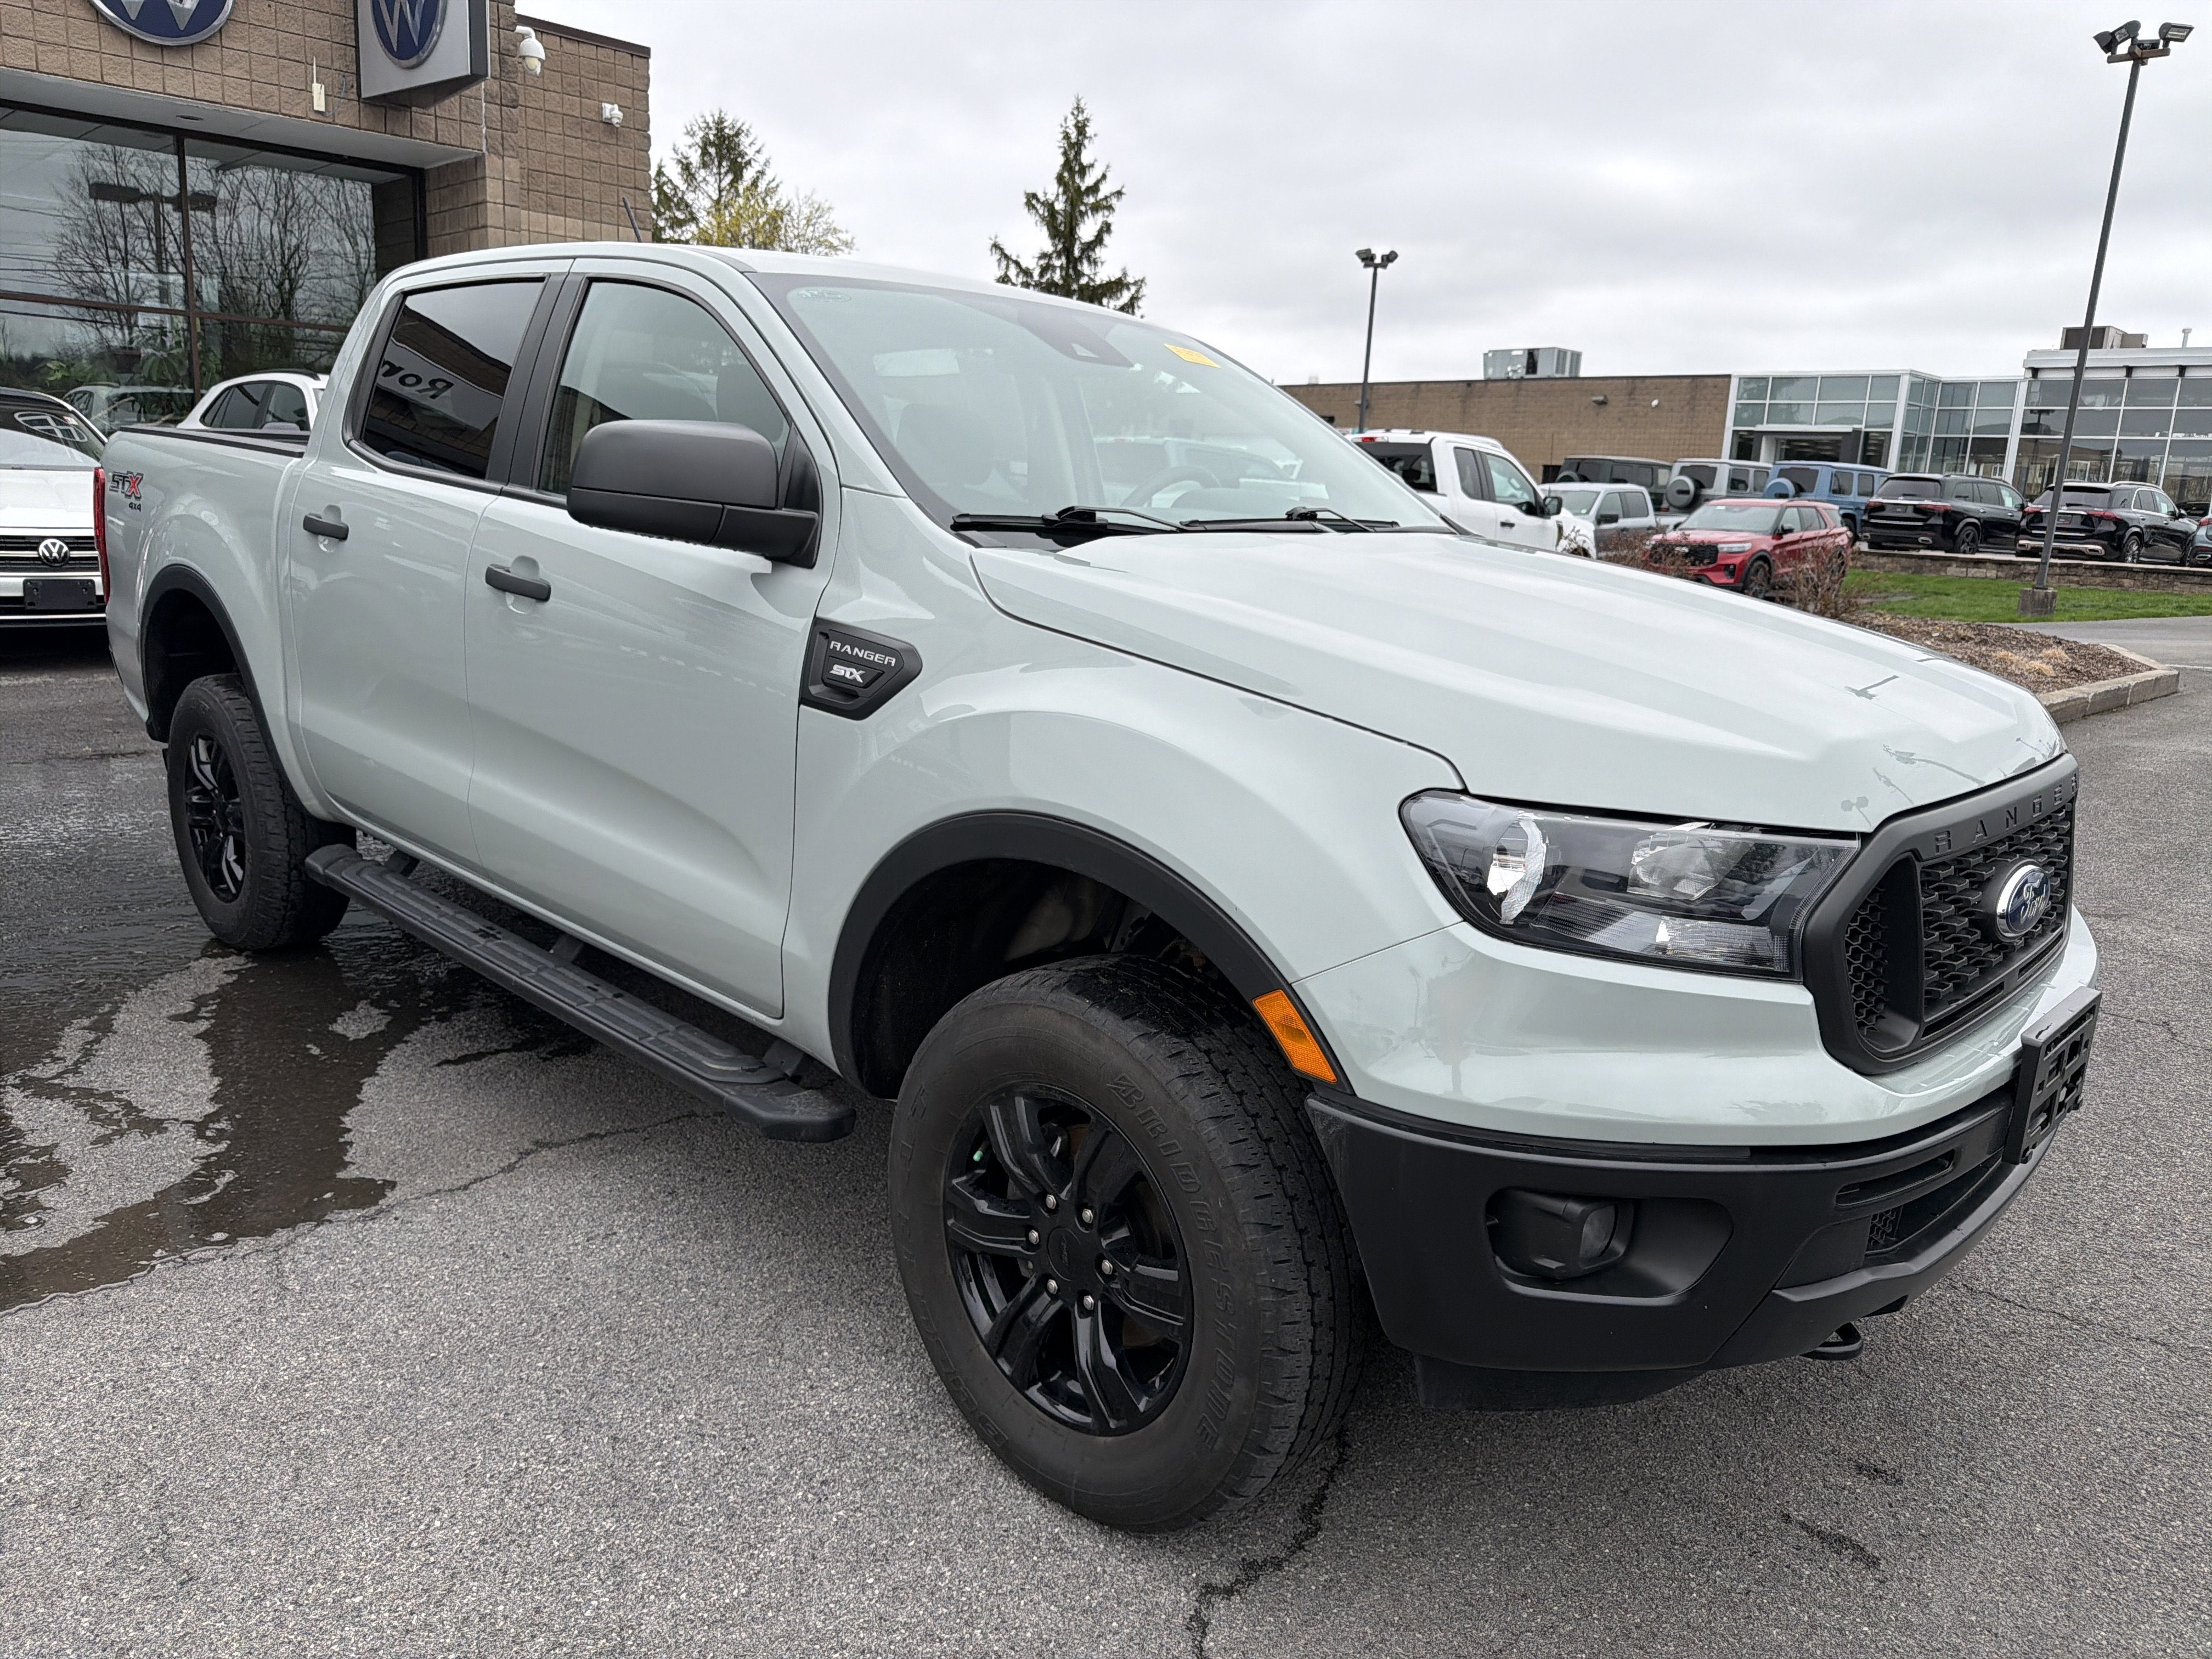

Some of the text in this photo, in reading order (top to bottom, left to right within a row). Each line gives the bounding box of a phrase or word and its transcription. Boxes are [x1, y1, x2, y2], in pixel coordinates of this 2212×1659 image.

[109, 470, 144, 501] STX
[830, 640, 896, 667] RANGER
[829, 664, 866, 683] STX
[1934, 773, 2077, 855] RANGER
[2020, 880, 2046, 924] Ford
[1107, 1073, 1235, 1452] BRIDGESTONE
